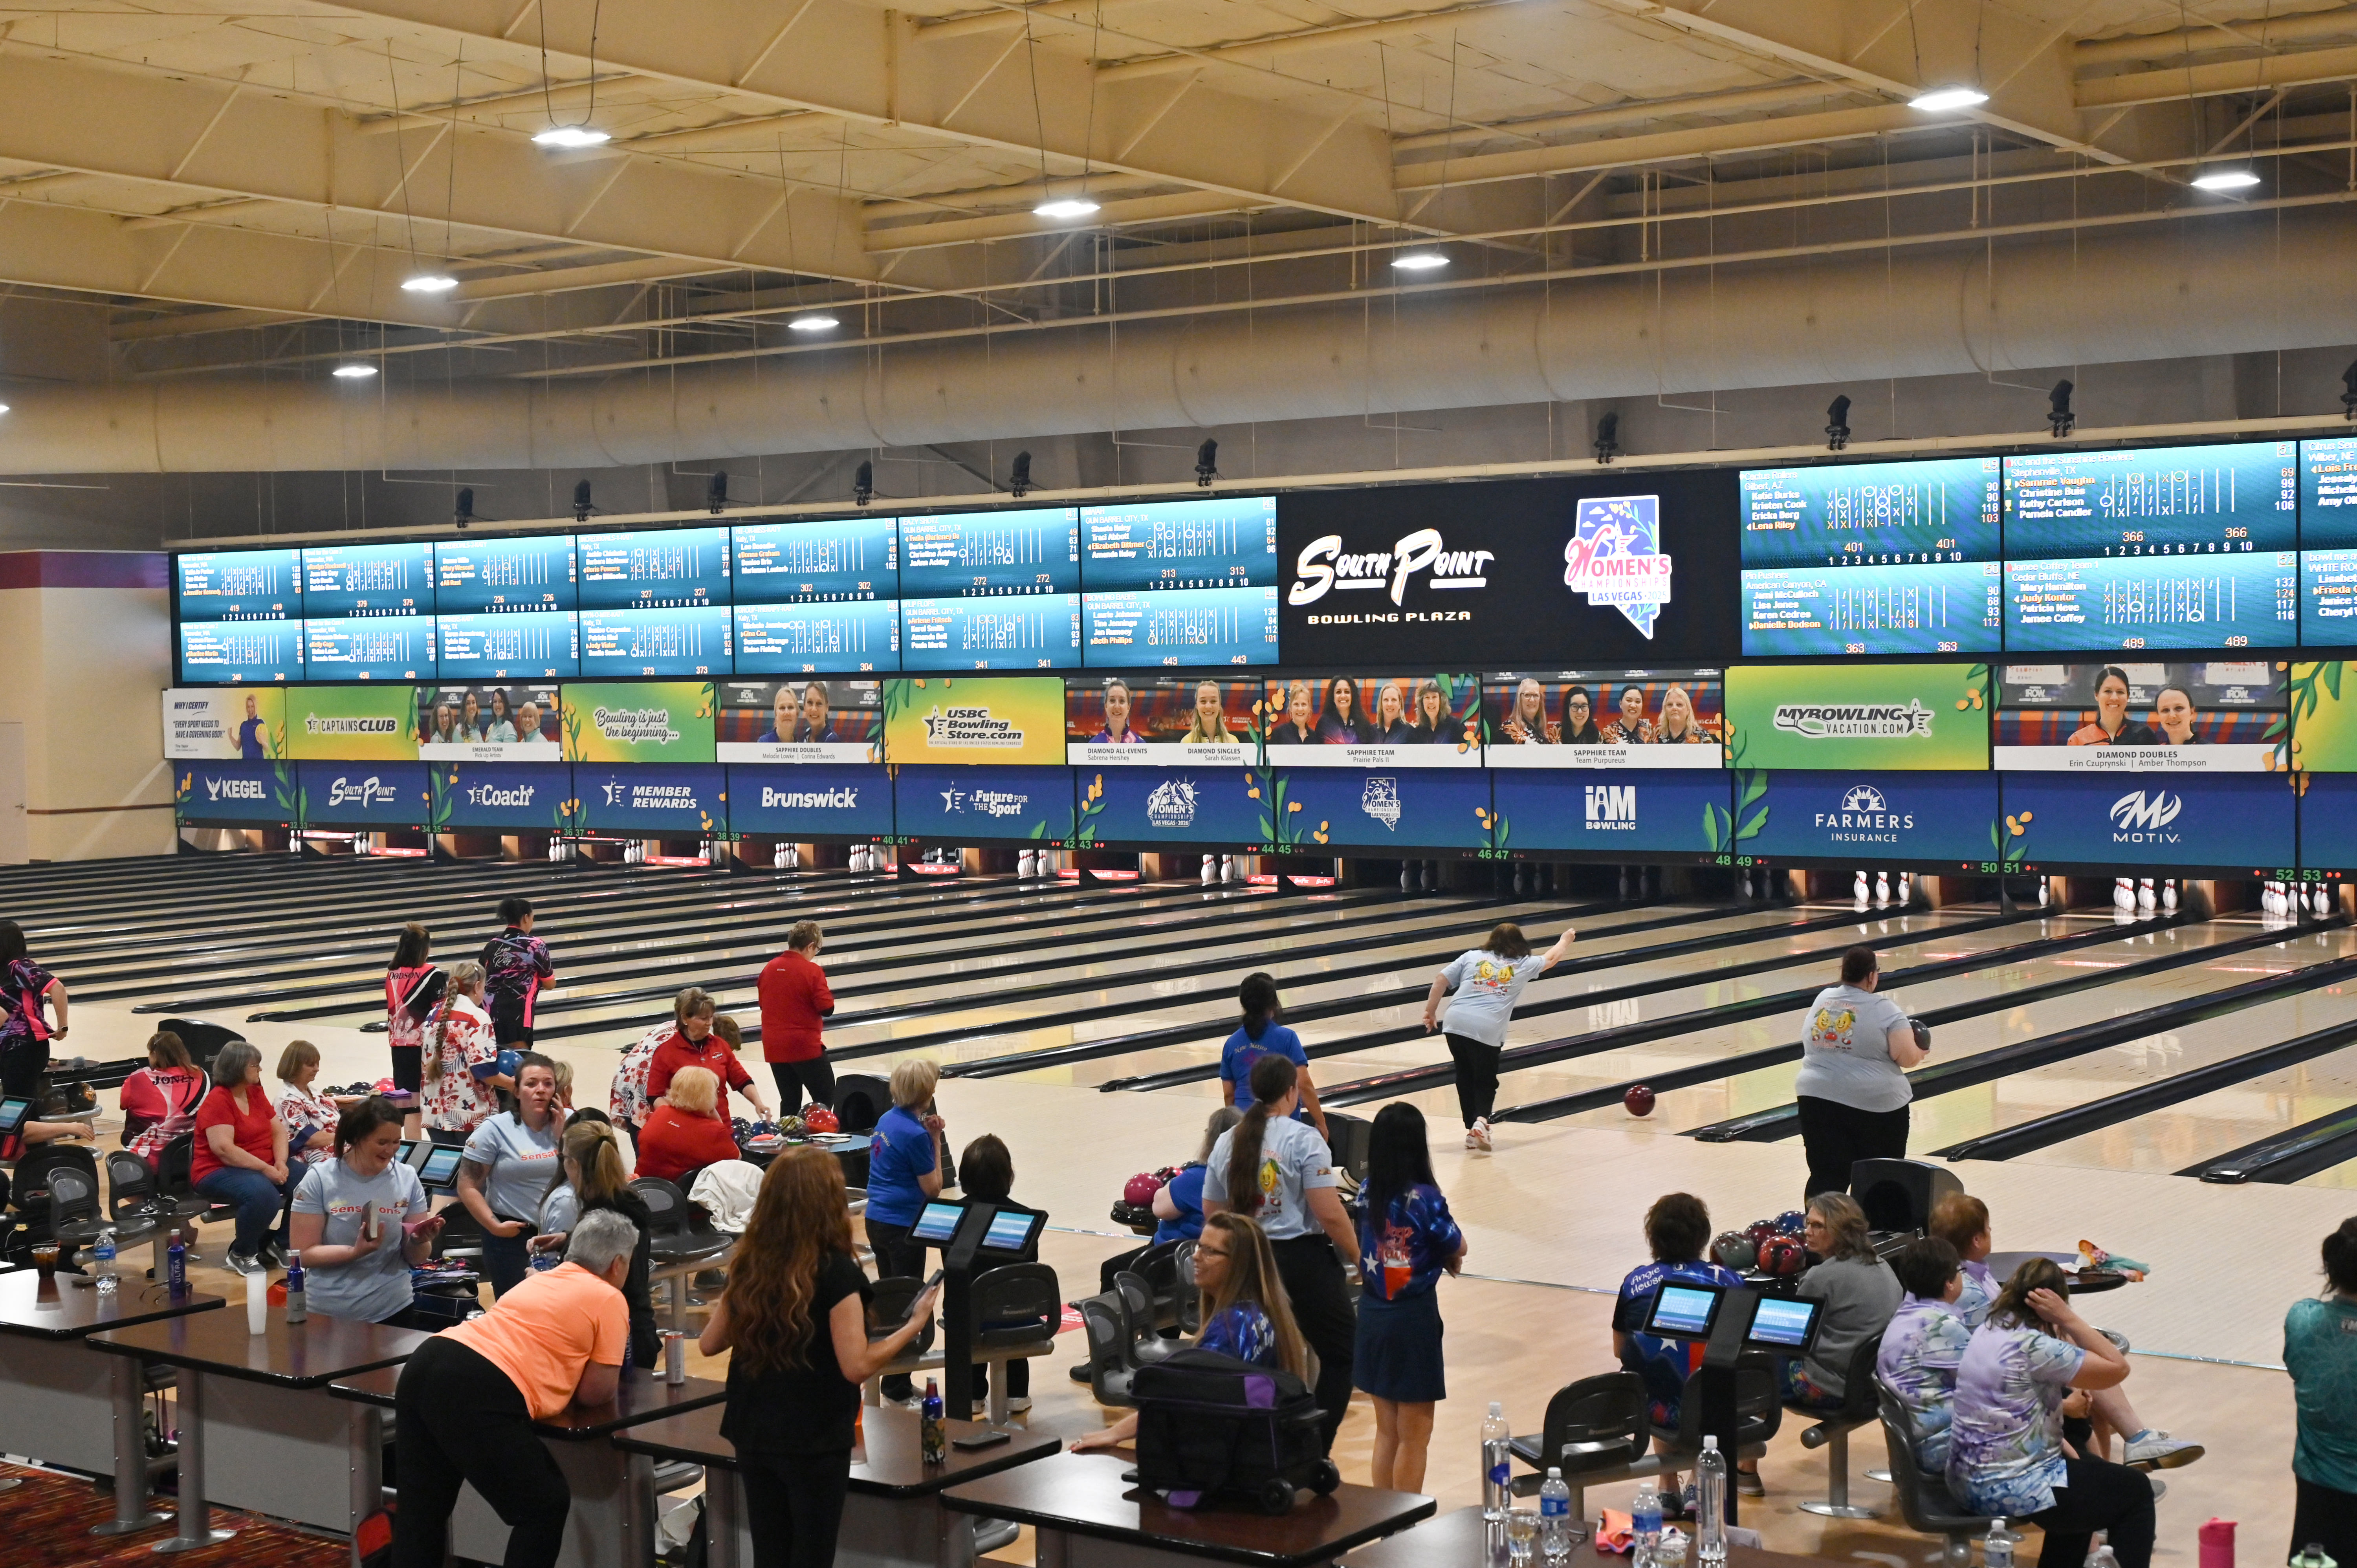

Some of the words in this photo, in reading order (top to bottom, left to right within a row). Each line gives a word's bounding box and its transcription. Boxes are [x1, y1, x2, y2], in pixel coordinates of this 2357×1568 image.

[1745, 482, 1770, 491] Gilbert,
[2019, 478, 2058, 487] Sammie
[2060, 476, 2095, 485] Vaughn
[1982, 504, 1998, 512] 118
[1982, 514, 1998, 522] 103
[1775, 521, 1796, 530] Riley
[2123, 531, 2143, 542] 366
[2225, 528, 2247, 538] 366
[1845, 542, 1863, 552] 401
[1936, 539, 1955, 548] 401
[1568, 528, 1669, 581] WOMEN'S
[1288, 535, 1392, 606] SOUTH
[1391, 528, 1494, 606] POINT
[1574, 577, 1666, 589] CHAMPIONSHIPS
[1593, 592, 1609, 601] LAS
[1611, 592, 1642, 601] VEGAS
[1648, 591, 1666, 600] 2025
[1308, 613, 1399, 624] BOWLING
[1406, 611, 1471, 621] PLAZA
[1754, 621, 1787, 629] Danielle
[1846, 643, 1864, 653] 363
[1938, 641, 1957, 651] 363
[1163, 657, 1177, 665] 443
[1231, 655, 1246, 664] 443
[595, 709, 636, 727] Bowling
[639, 712, 647, 723] is
[645, 712, 666, 727] just
[948, 710, 987, 718] USBC
[1778, 708, 1903, 720] MYBOWLING
[948, 720, 1009, 731] Bowling
[1826, 724, 1903, 734] VACATION.COM
[606, 726, 619, 736] the
[948, 731, 1022, 739] Store.com
[2086, 759, 2126, 769] Czuprynski
[2166, 760, 2207, 769] Thompson
[222, 780, 266, 799] KEGEL
[329, 777, 363, 806] SOUTH
[363, 777, 396, 808] POINT
[632, 786, 691, 797] MEMBER
[482, 784, 534, 806] Coach+
[761, 787, 857, 808] Brunswick
[975, 790, 1013, 802] Future
[1364, 788, 1400, 808] WOMEN'S
[632, 798, 696, 808] REWARDS
[1148, 789, 1193, 815] WOMEN'S
[988, 801, 1021, 817] Sport
[1586, 821, 1636, 830] BOWLING
[1815, 813, 1913, 829] FARMERS
[564, 828, 572, 837] 36
[576, 828, 584, 837] 37
[717, 832, 726, 840] 38
[730, 832, 740, 841] 39
[1831, 833, 1897, 842] INSURANCE
[883, 836, 893, 845] 40
[897, 836, 908, 845] 41
[2113, 833, 2179, 843] MOTIV
[1064, 840, 1075, 849] 42
[1080, 841, 1091, 849] 43
[1261, 845, 1274, 854] 44
[1278, 845, 1291, 854] 45
[1478, 849, 1492, 859] 46
[1495, 850, 1509, 859] 47
[1716, 855, 1731, 865] 48
[1736, 856, 1752, 866] 49
[1981, 863, 1998, 872] 50
[2004, 863, 2020, 873] 51
[2276, 869, 2294, 881] 52
[2302, 870, 2321, 881] 53
[1631, 1267, 1660, 1285] Angie
[1631, 1275, 1663, 1295] Howse
